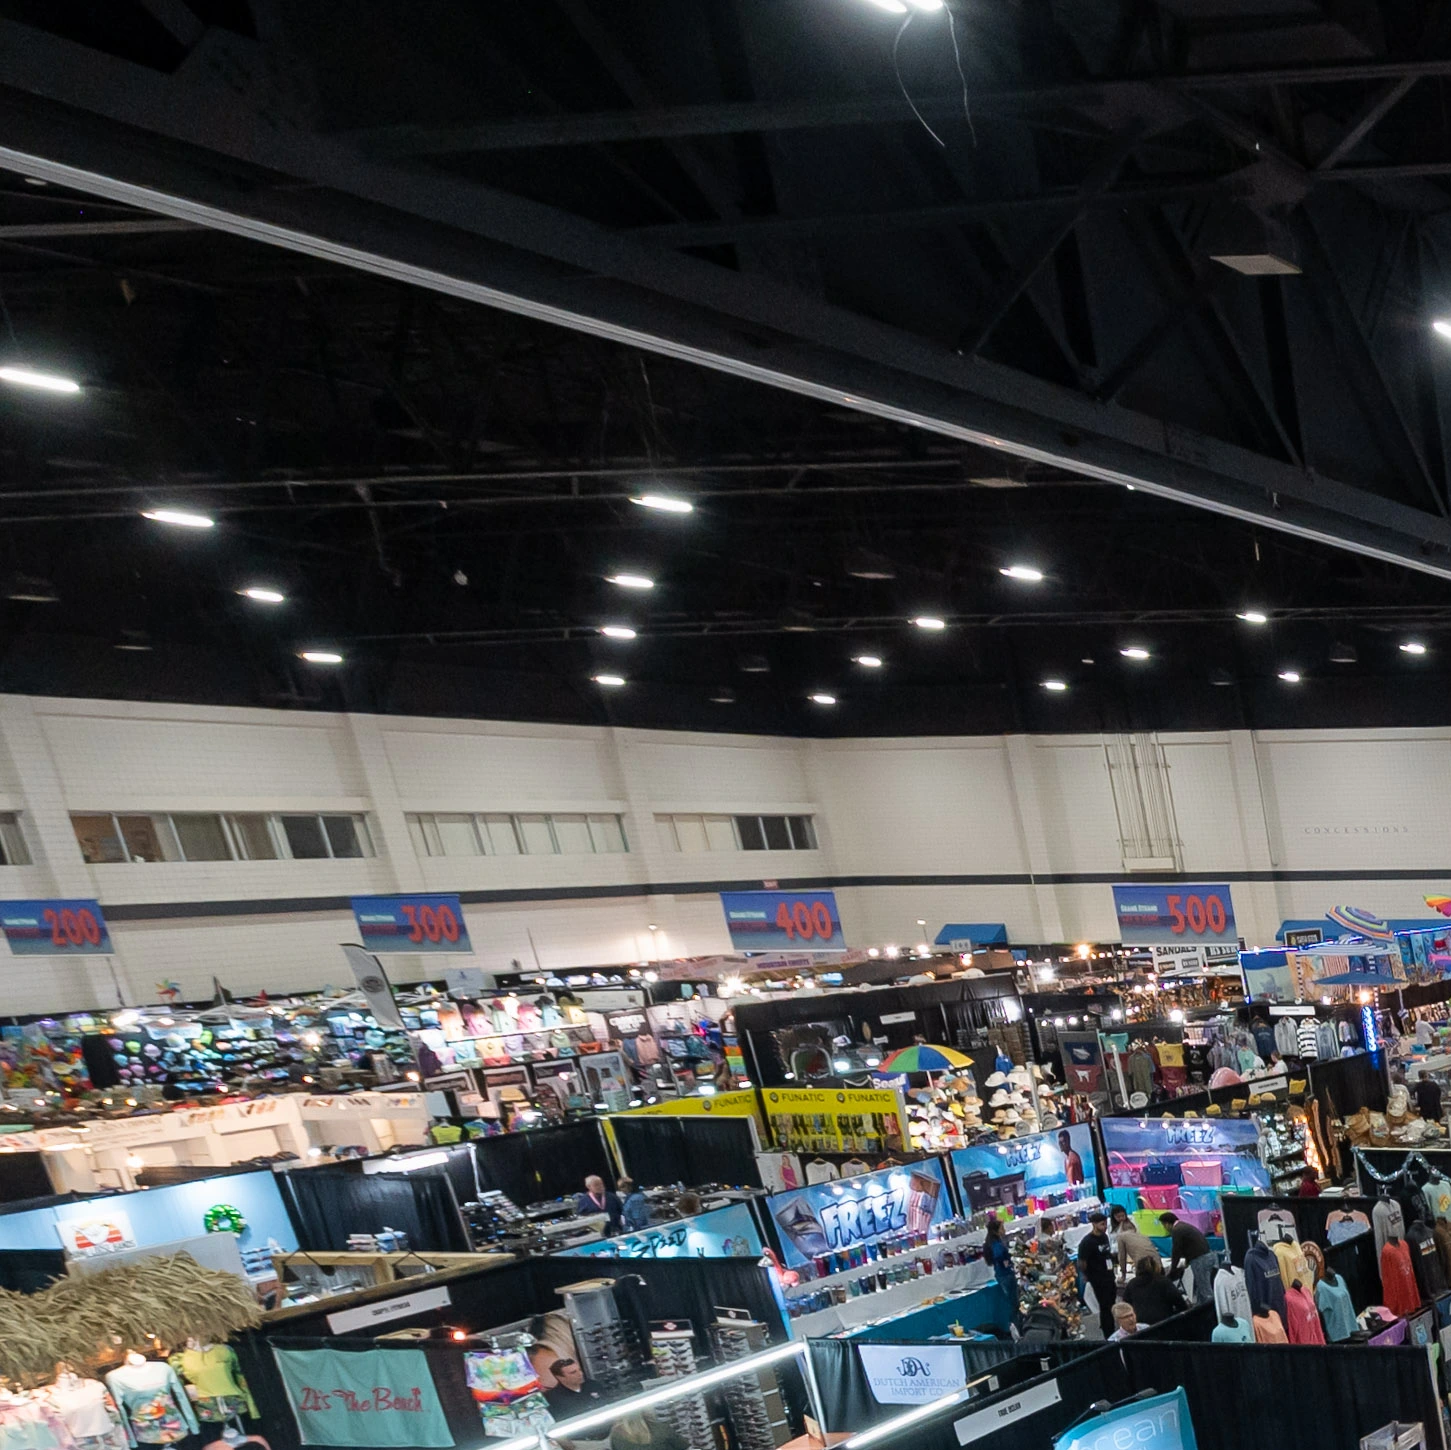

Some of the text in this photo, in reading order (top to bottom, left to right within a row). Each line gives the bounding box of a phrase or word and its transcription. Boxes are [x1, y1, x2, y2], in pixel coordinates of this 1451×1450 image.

[44, 908, 101, 946] 200
[402, 904, 460, 942] 300
[776, 901, 834, 941] 400
[1166, 894, 1226, 935] 500
[781, 1092, 825, 1103] FUNATIC
[847, 1093, 891, 1105] FUNATIC
[1166, 1125, 1216, 1144] FREEZ
[820, 1189, 907, 1249] FREEZ
[874, 1378, 960, 1388] DUTCH AMERICAN
[891, 1387, 926, 1398] IMPORT
